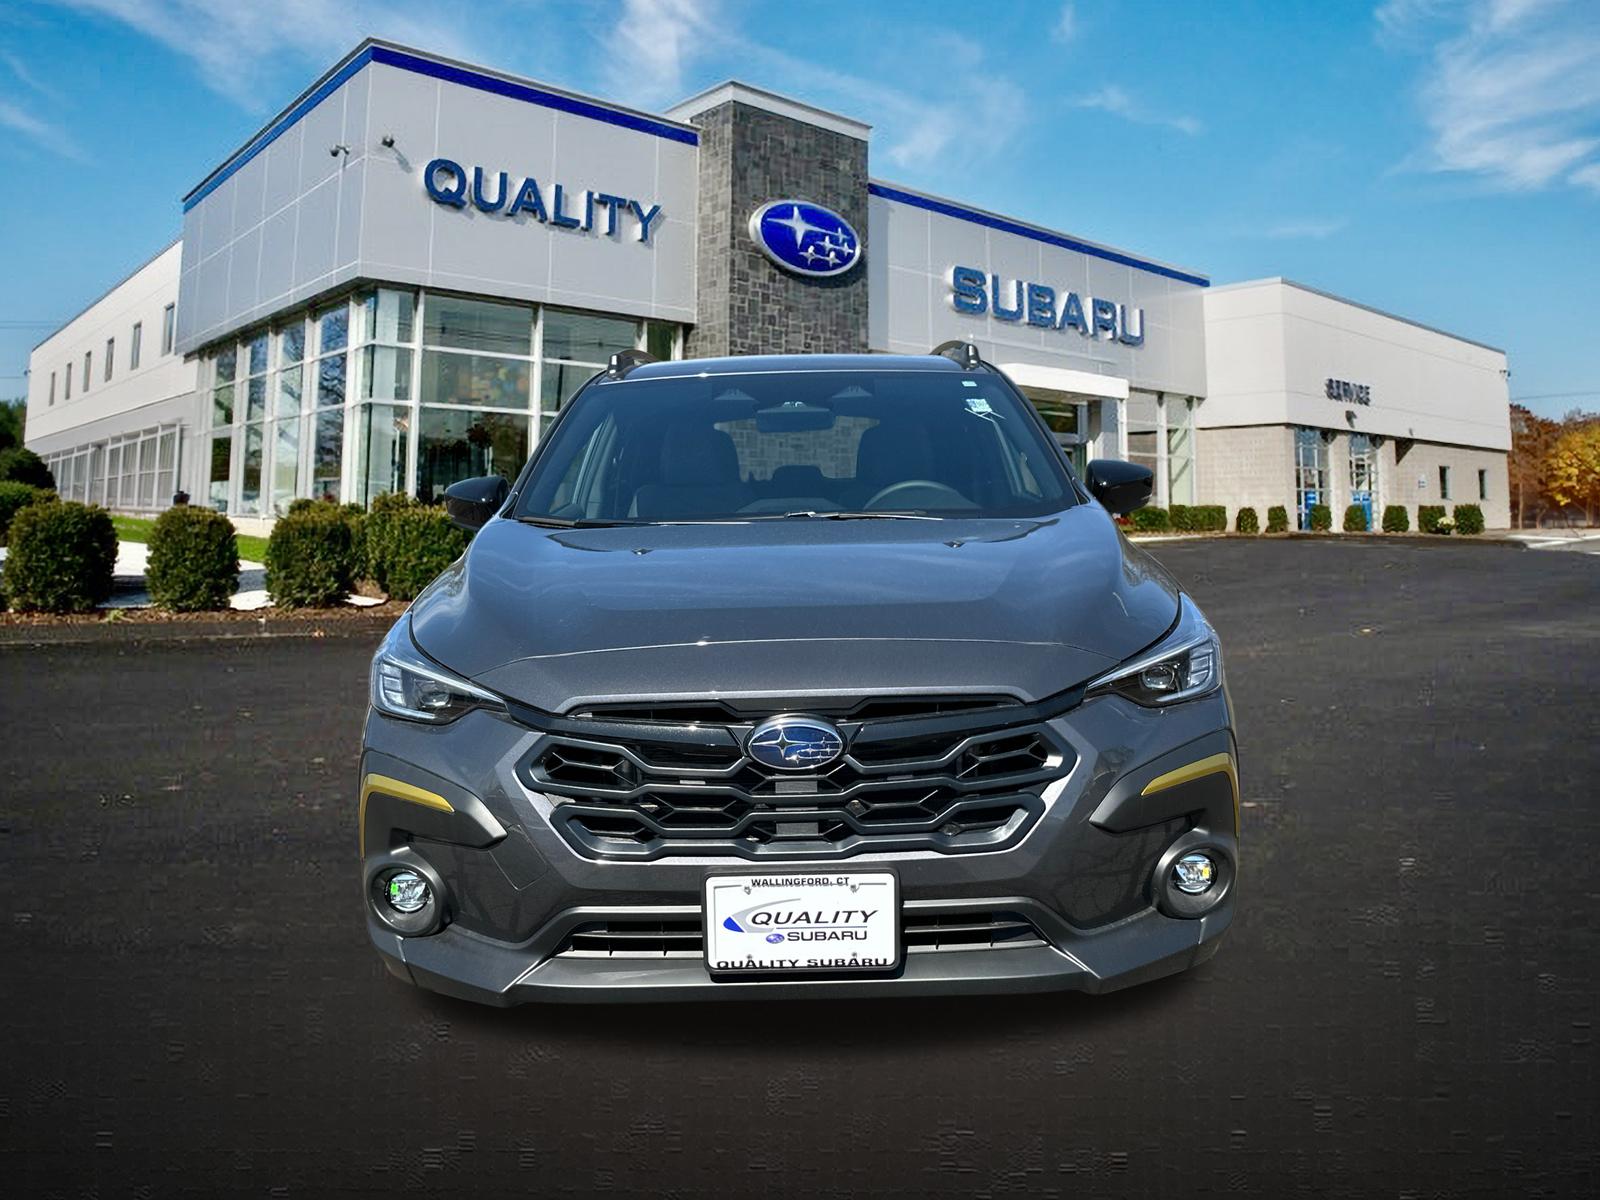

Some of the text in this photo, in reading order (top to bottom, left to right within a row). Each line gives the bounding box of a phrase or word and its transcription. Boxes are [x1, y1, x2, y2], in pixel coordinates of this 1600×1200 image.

[423, 158, 662, 242] QUALITY
[946, 265, 1145, 346] SUBARU
[836, 876, 850, 886] CT
[750, 910, 879, 925] QUALITY
[787, 930, 868, 941] SUBARU
[716, 957, 888, 970] QUALITY SUBARU
